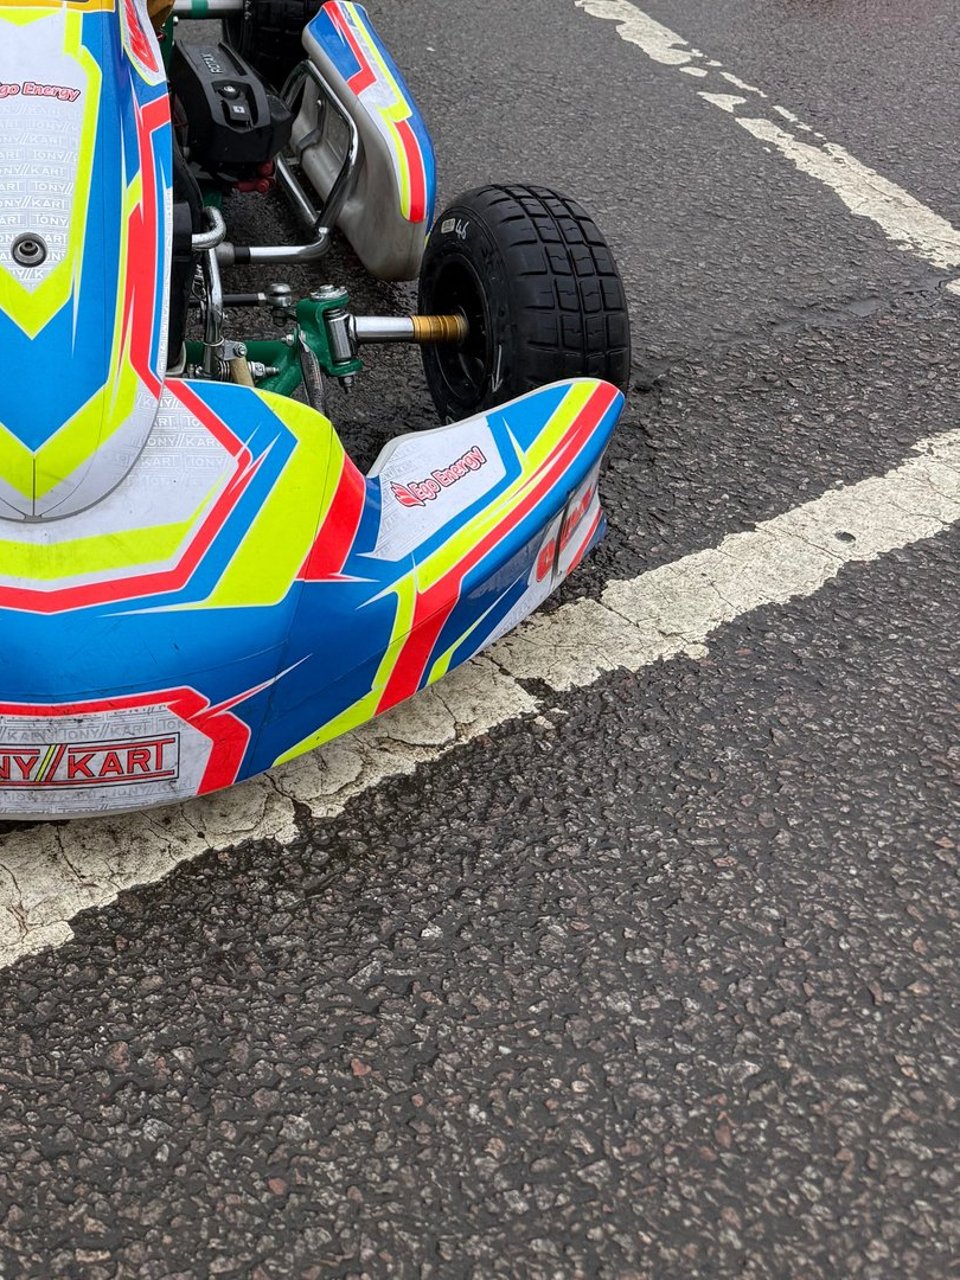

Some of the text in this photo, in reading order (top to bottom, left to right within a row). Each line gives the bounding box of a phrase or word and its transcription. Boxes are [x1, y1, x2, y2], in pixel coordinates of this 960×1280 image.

[21, 81, 81, 102] Energy
[455, 218, 470, 240] 46
[407, 479, 441, 500] Ego
[431, 446, 487, 488] Energy
